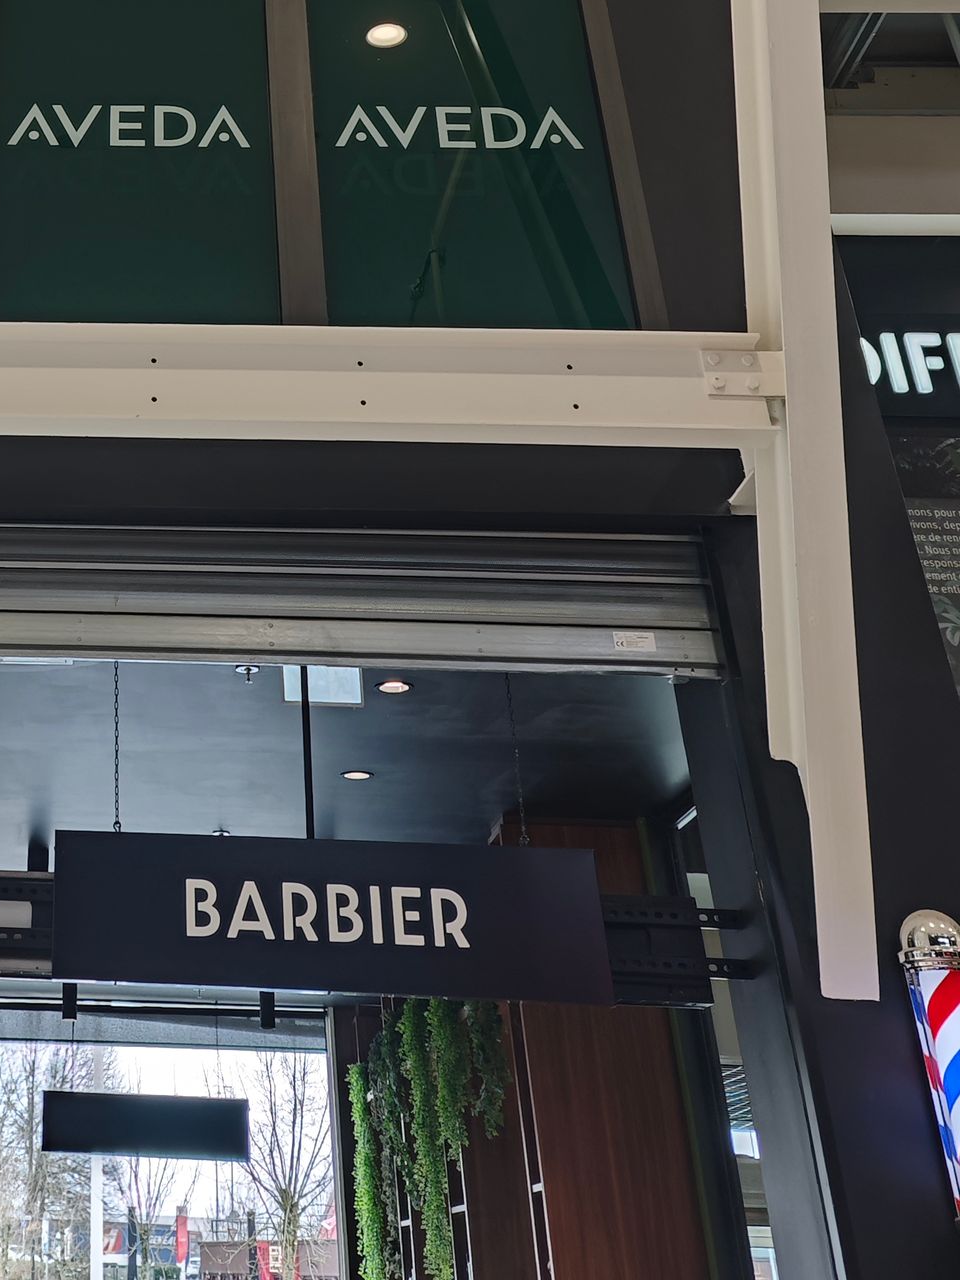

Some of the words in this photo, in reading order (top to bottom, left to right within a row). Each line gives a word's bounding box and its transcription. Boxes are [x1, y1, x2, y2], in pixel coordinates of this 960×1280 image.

[7, 103, 251, 148] AVEDA
[335, 105, 584, 150] AVEDA
[934, 509, 956, 518] pour
[924, 545, 951, 555] Nous
[928, 532, 941, 542] de
[943, 534, 960, 542] ren
[185, 878, 471, 949] BARBIER
